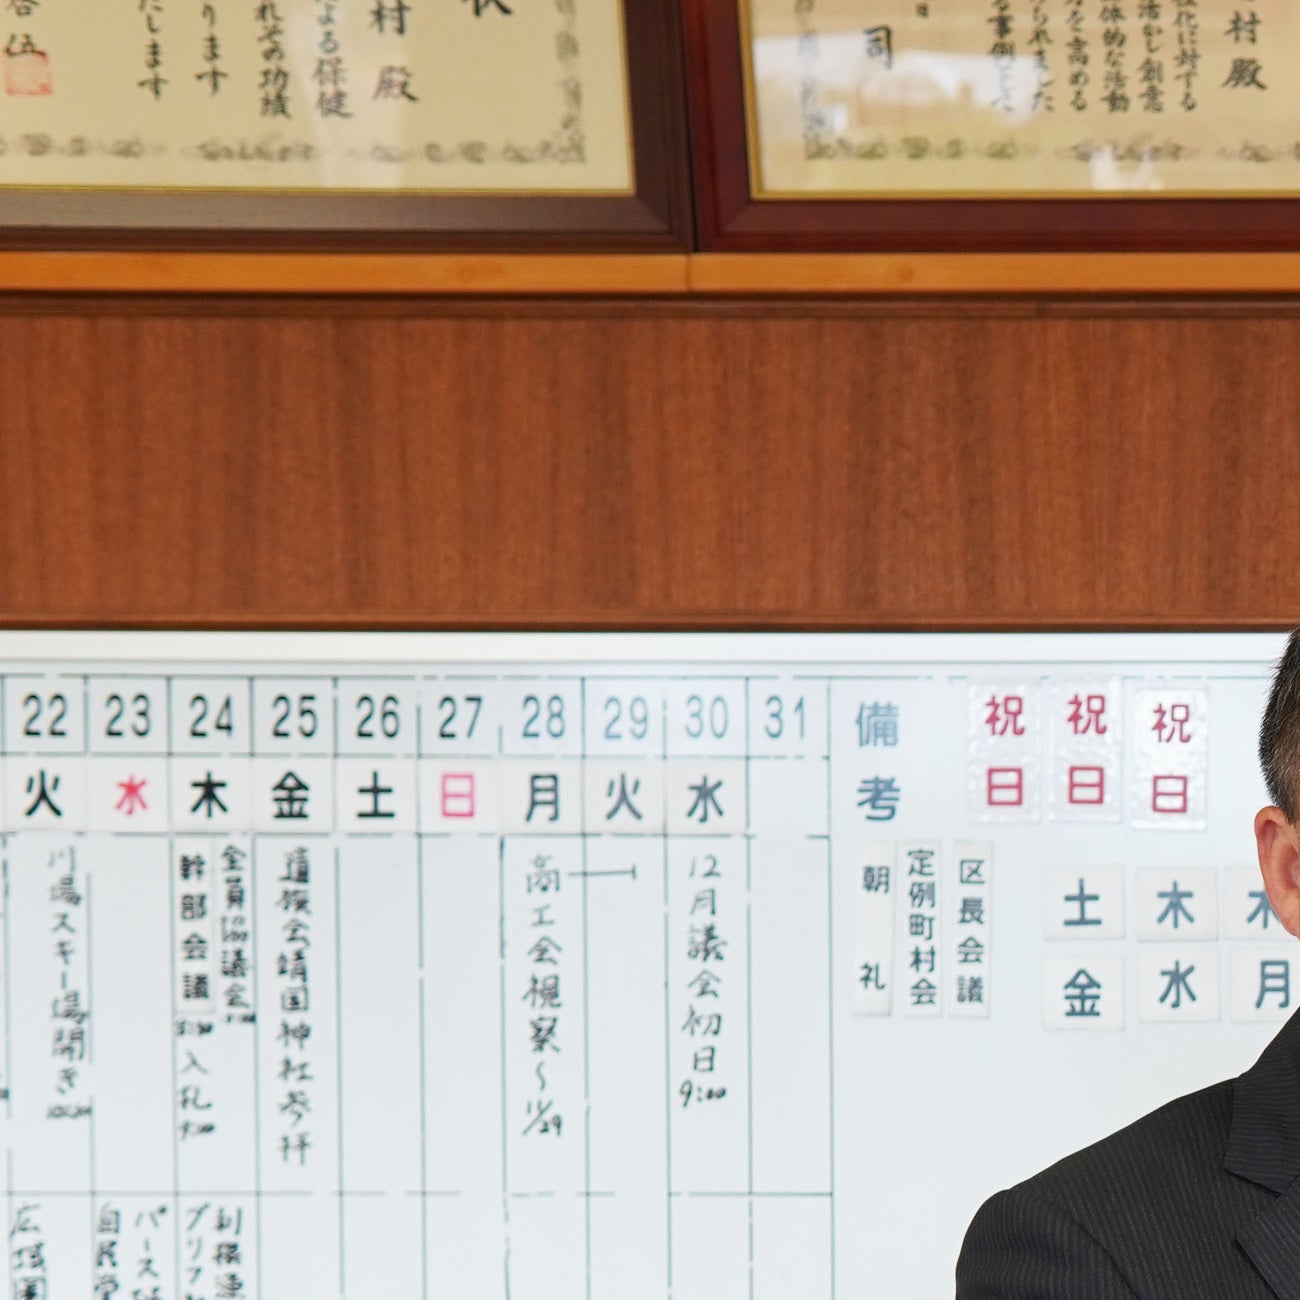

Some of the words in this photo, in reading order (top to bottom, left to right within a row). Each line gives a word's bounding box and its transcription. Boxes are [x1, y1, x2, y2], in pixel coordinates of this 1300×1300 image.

[862, 25, 894, 70] 司
[373, 65, 418, 102] 殿
[24, 693, 66, 737] 22
[105, 693, 150, 737] 23
[190, 694, 233, 738] 24
[272, 694, 316, 738] 25
[356, 695, 399, 739] 26
[439, 695, 482, 739] 27
[522, 694, 564, 739] 28
[604, 696, 648, 740] 29
[685, 694, 728, 740] 30
[765, 695, 804, 739] 31
[856, 703, 900, 822] 備考
[983, 692, 1026, 806] 祝日
[1066, 692, 1108, 806] 祝日
[1150, 702, 1192, 814] 祝日
[25, 770, 62, 817] 火
[116, 778, 147, 815] 水
[190, 772, 228, 818] 木
[272, 771, 309, 819] 金
[356, 771, 396, 819] 土
[441, 774, 475, 818] 日
[525, 773, 559, 822] 月
[605, 773, 643, 821] 火
[686, 775, 724, 824] 水
[1063, 877, 1103, 927] 土
[1156, 880, 1195, 929] 木
[180, 854, 210, 1000] 幹部会議
[858, 866, 890, 992] 朝礼
[906, 848, 937, 1008] 定例町村会
[956, 858, 985, 1006] 区長会議
[276, 846, 313, 1165] 遺族会靖国神社参拝
[1063, 969, 1102, 1017] 金
[1159, 960, 1197, 1009] 水
[1255, 960, 1290, 1009] 月
